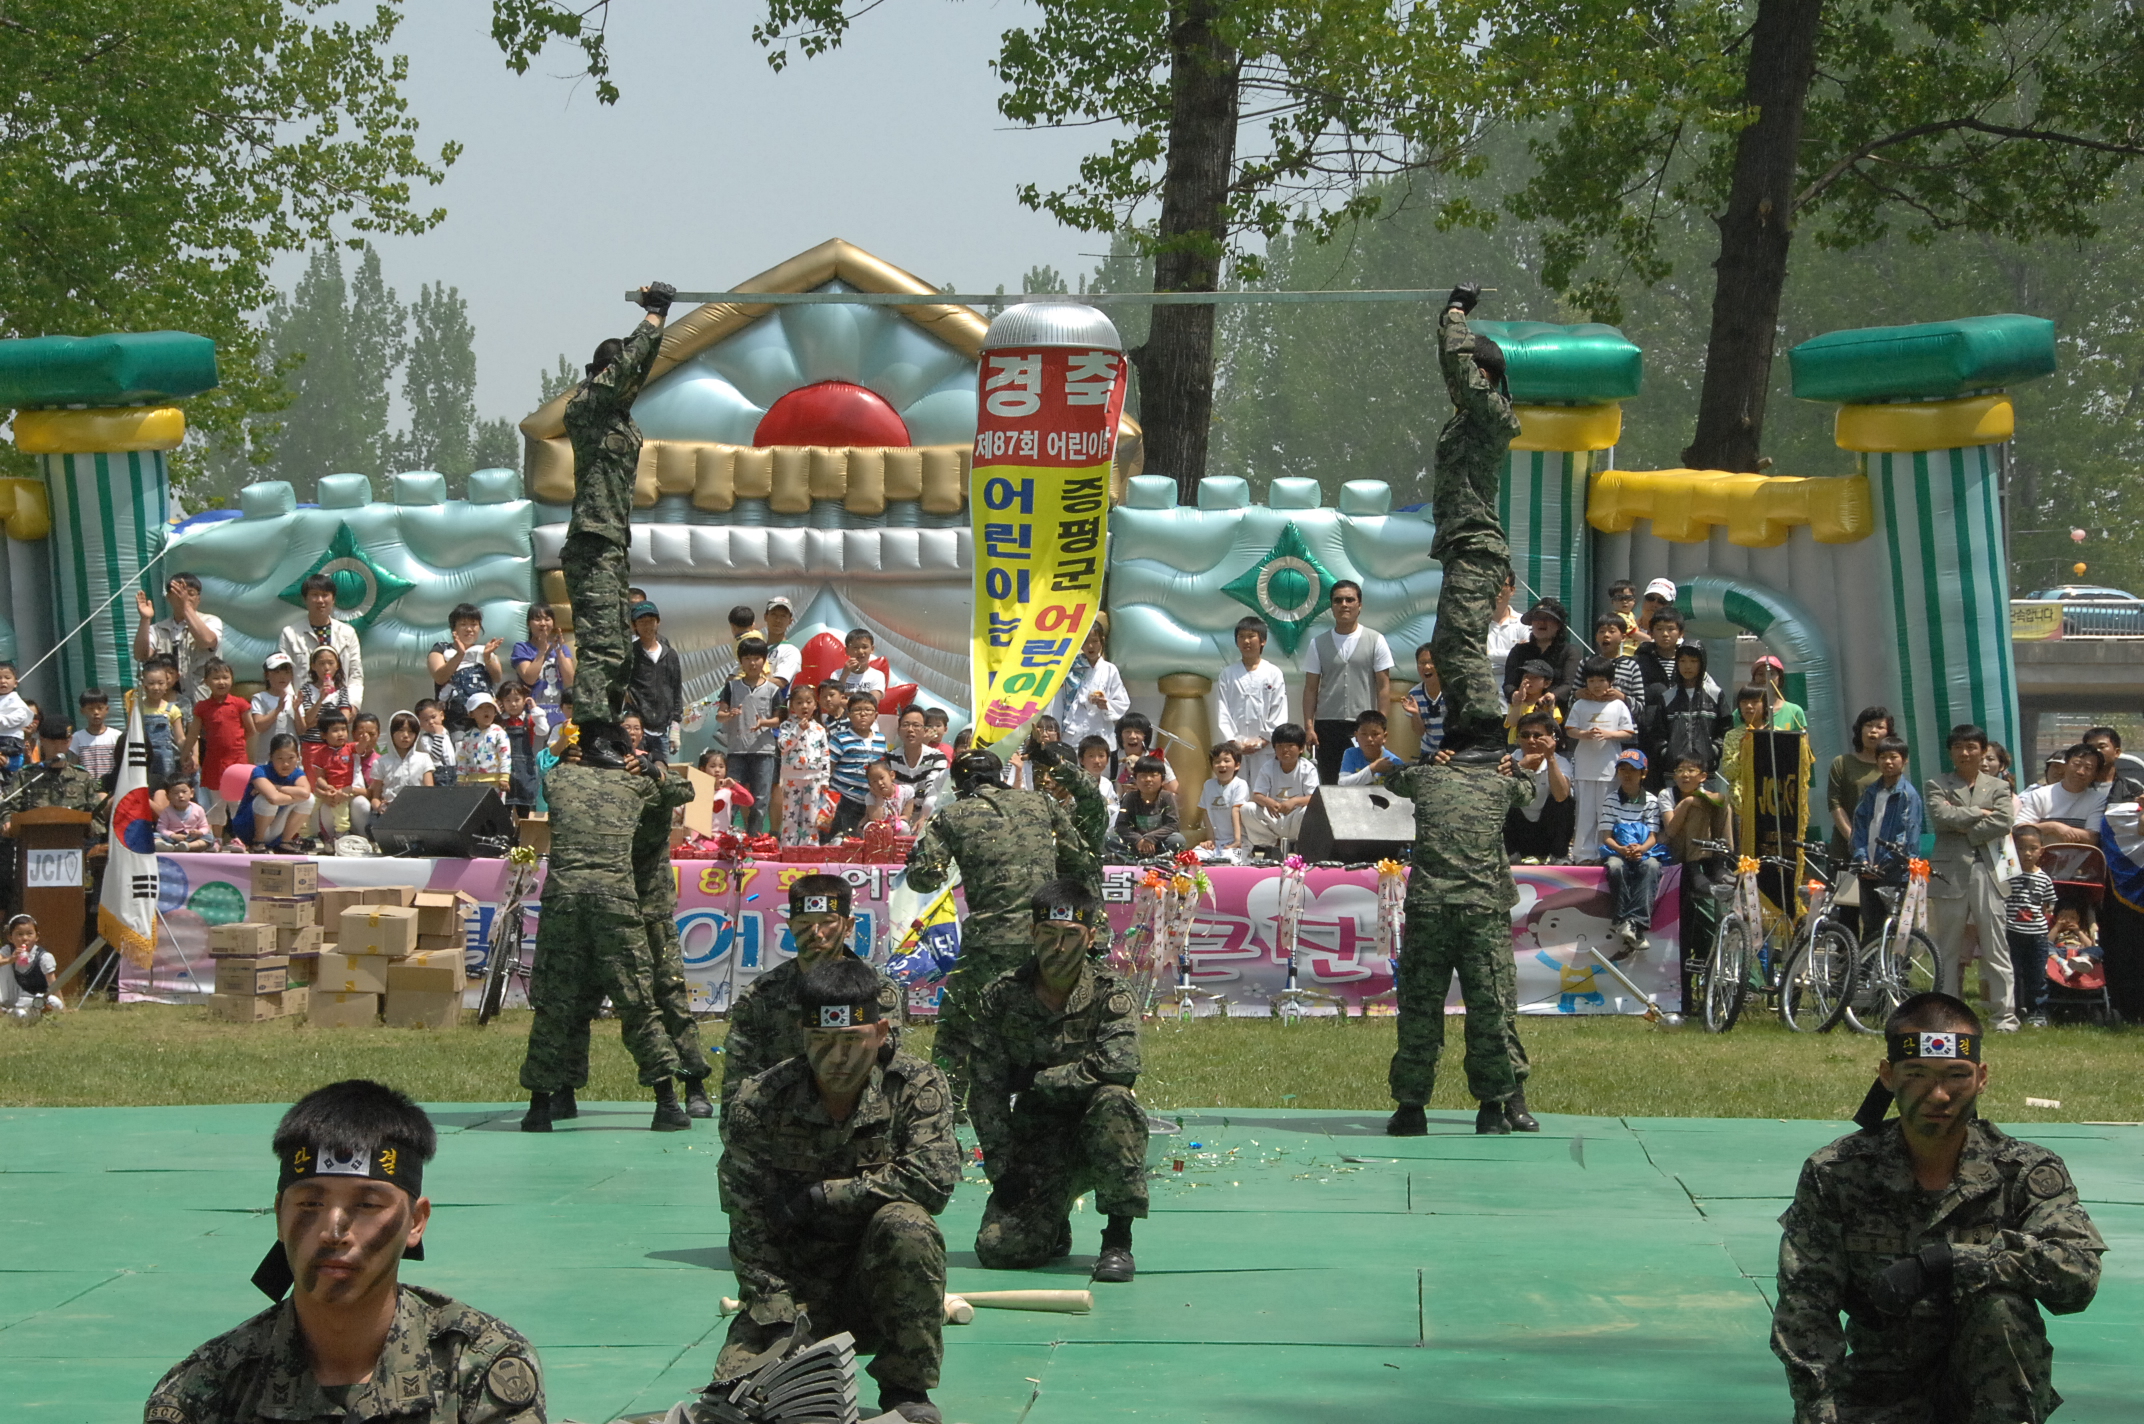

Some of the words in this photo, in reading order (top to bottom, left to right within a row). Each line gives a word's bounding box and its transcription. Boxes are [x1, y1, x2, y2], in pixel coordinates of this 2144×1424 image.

[975, 430, 1039, 460] 제87회
[1050, 476, 1104, 592] 증평군
[29, 854, 61, 882] JCI
